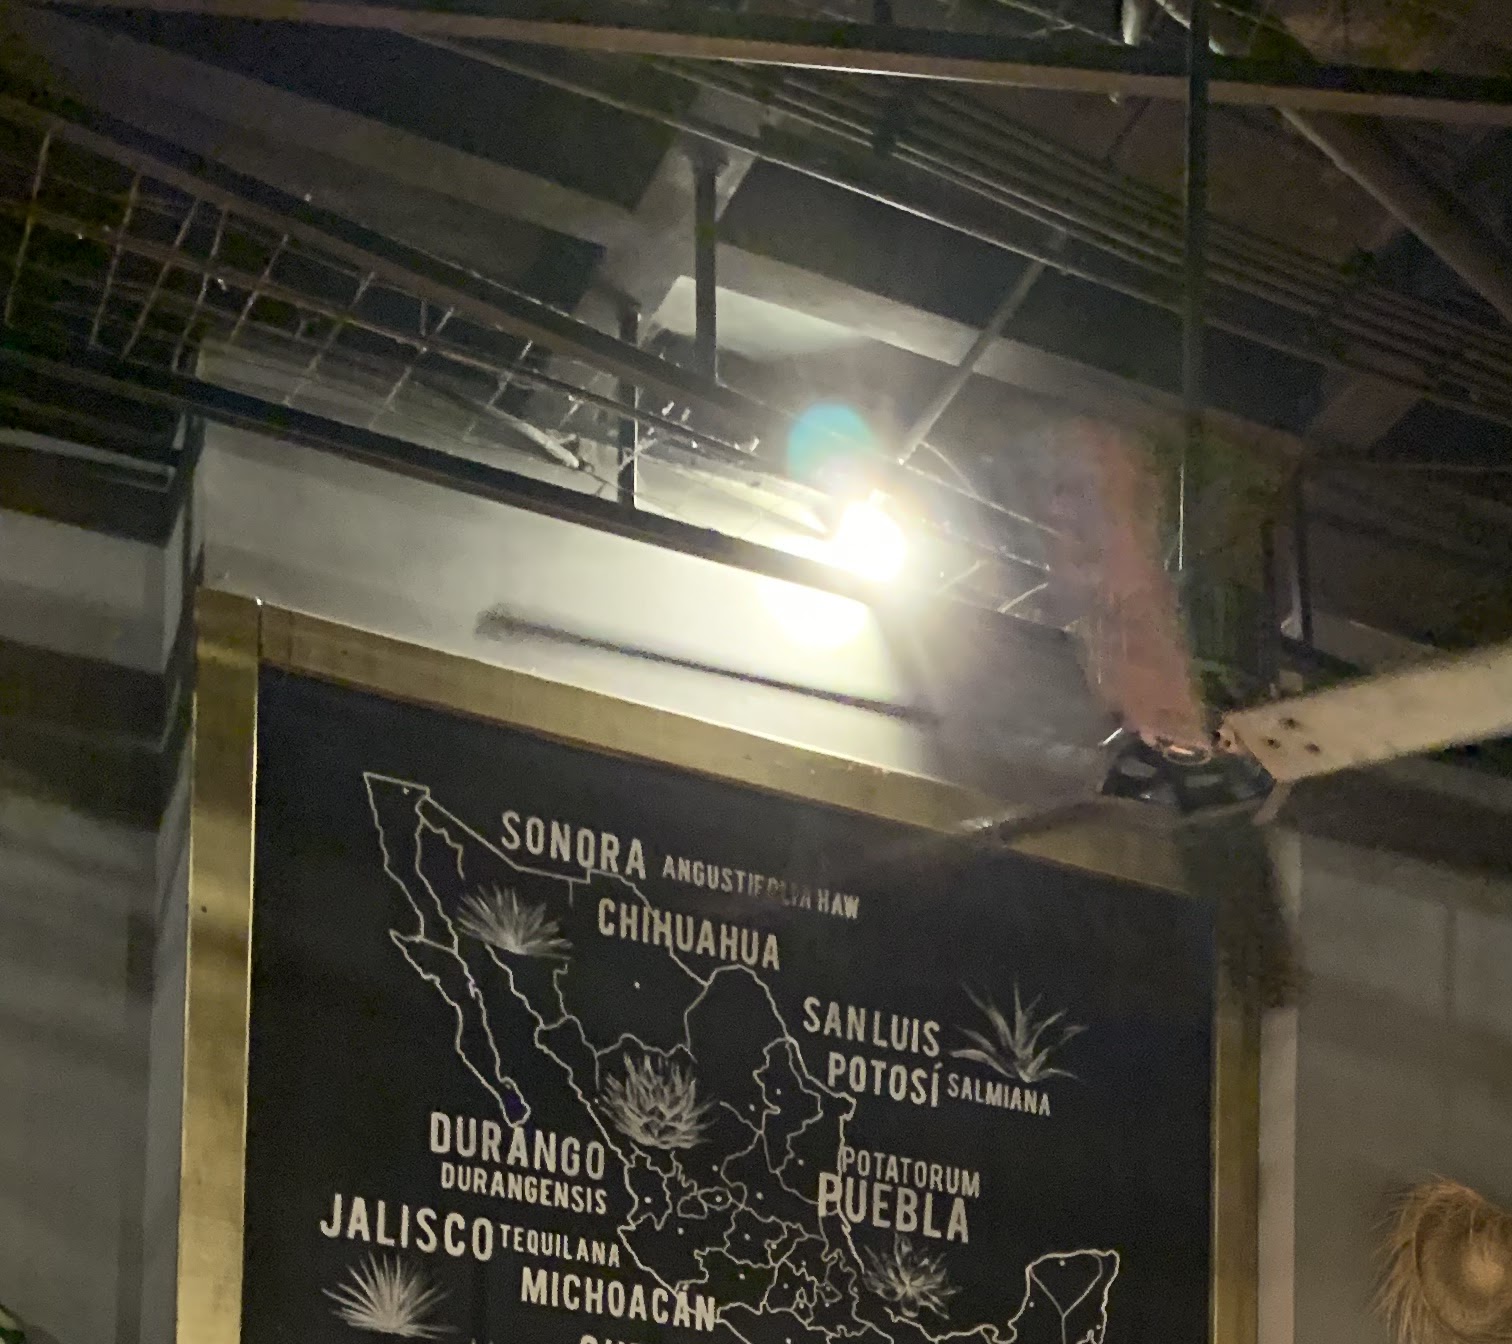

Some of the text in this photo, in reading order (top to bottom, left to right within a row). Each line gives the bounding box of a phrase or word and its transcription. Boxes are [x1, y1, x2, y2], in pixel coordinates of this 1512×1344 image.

[501, 810, 646, 880] SONORA
[817, 888, 860, 919] HAW
[598, 898, 780, 971] CHIHUAHUA
[803, 996, 941, 1058] SAN LUIS
[827, 1041, 1051, 1117] POTOSÍ SALMIANA
[430, 1111, 606, 1181] DURANGO
[839, 1146, 980, 1198] POTATORUM
[440, 1161, 608, 1215] DURANGENSIS
[817, 1171, 969, 1244] PUEBLA
[319, 1193, 621, 1268] JALISCO TEQUILANA
